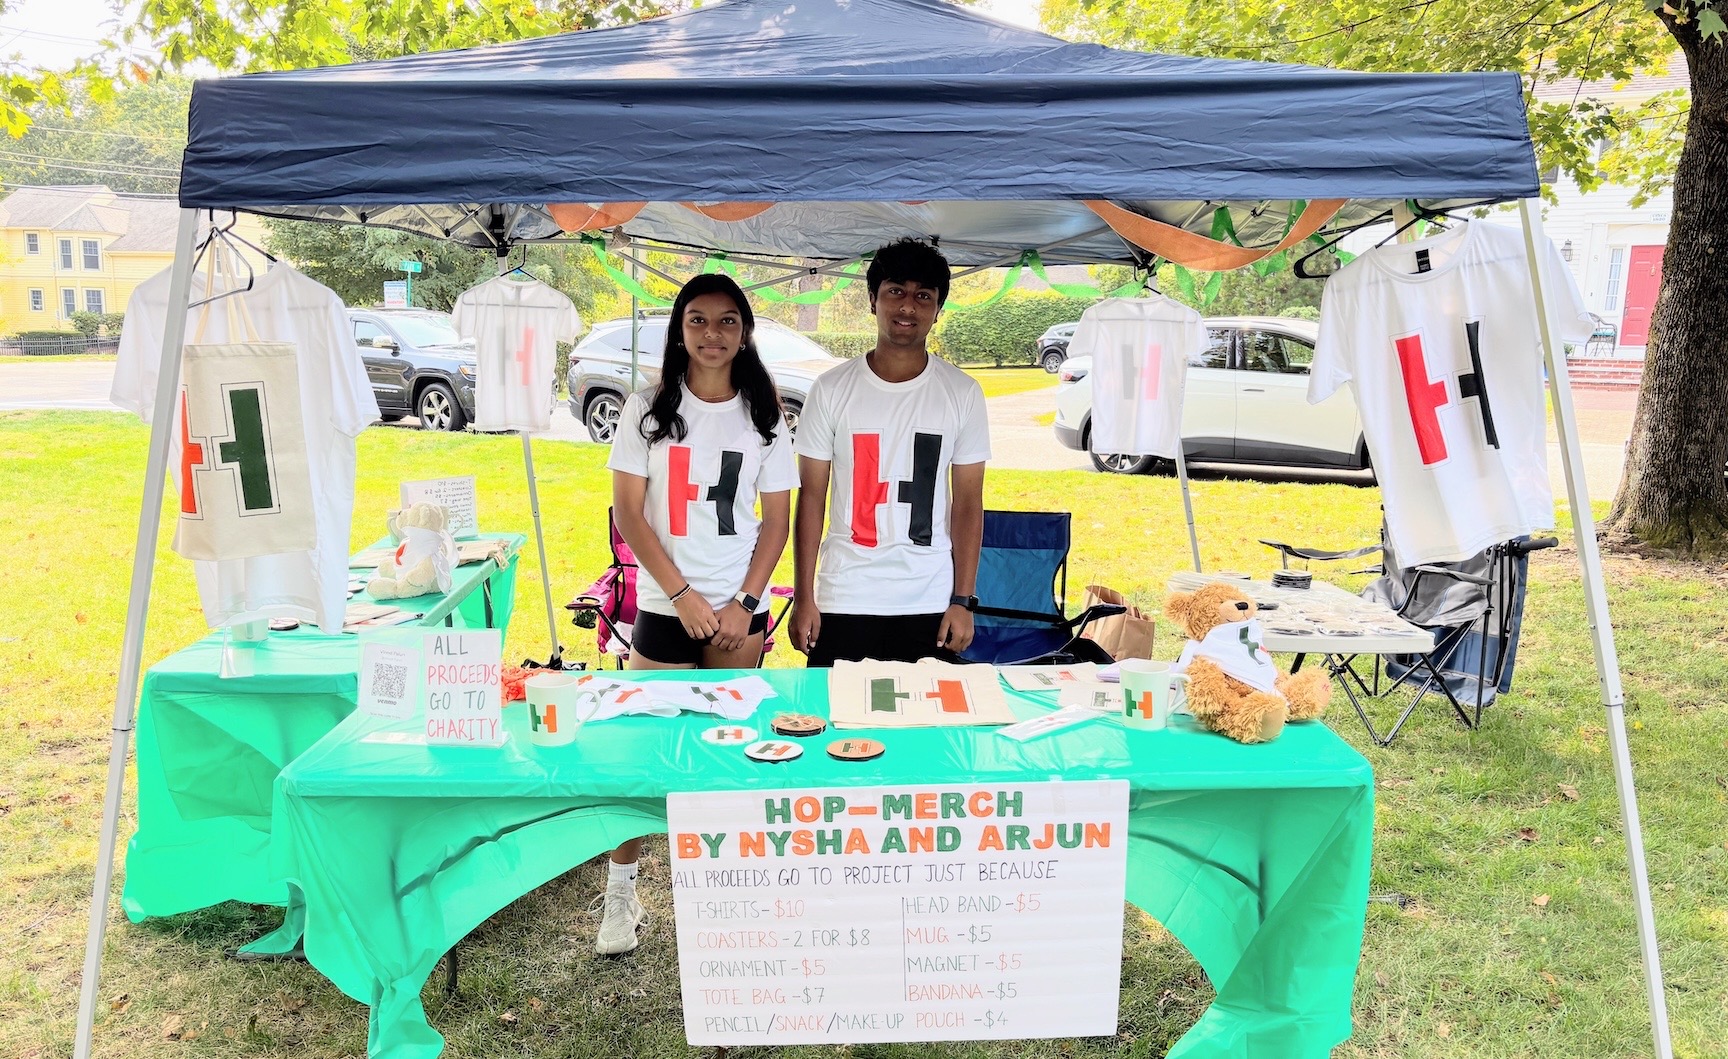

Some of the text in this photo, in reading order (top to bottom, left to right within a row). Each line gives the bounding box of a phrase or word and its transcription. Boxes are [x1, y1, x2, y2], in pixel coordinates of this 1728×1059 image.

[434, 634, 469, 656] ALL
[427, 663, 499, 686] PROCEEDS
[429, 689, 486, 711] GO TO
[427, 718, 498, 742] CHARITY
[764, 791, 1024, 825] HOP-MERCH
[676, 822, 1112, 859] BY NYSHA AND ARJUN
[673, 860, 1060, 889] ALL PROCEEDS GO TO PROJECT JUST BECAUSE
[905, 896, 950, 914] HEAD
[957, 894, 1002, 913] BAND
[811, 929, 841, 948] FOR
[848, 926, 871, 948] $8
[906, 927, 950, 945] MUG
[699, 959, 788, 978] ORNAMENT
[907, 954, 980, 973] MAGNET
[699, 988, 744, 1006] TOTE
[751, 988, 786, 1005] BAG
[908, 982, 984, 1002] BANDANA
[915, 1011, 966, 1030] POUCH
